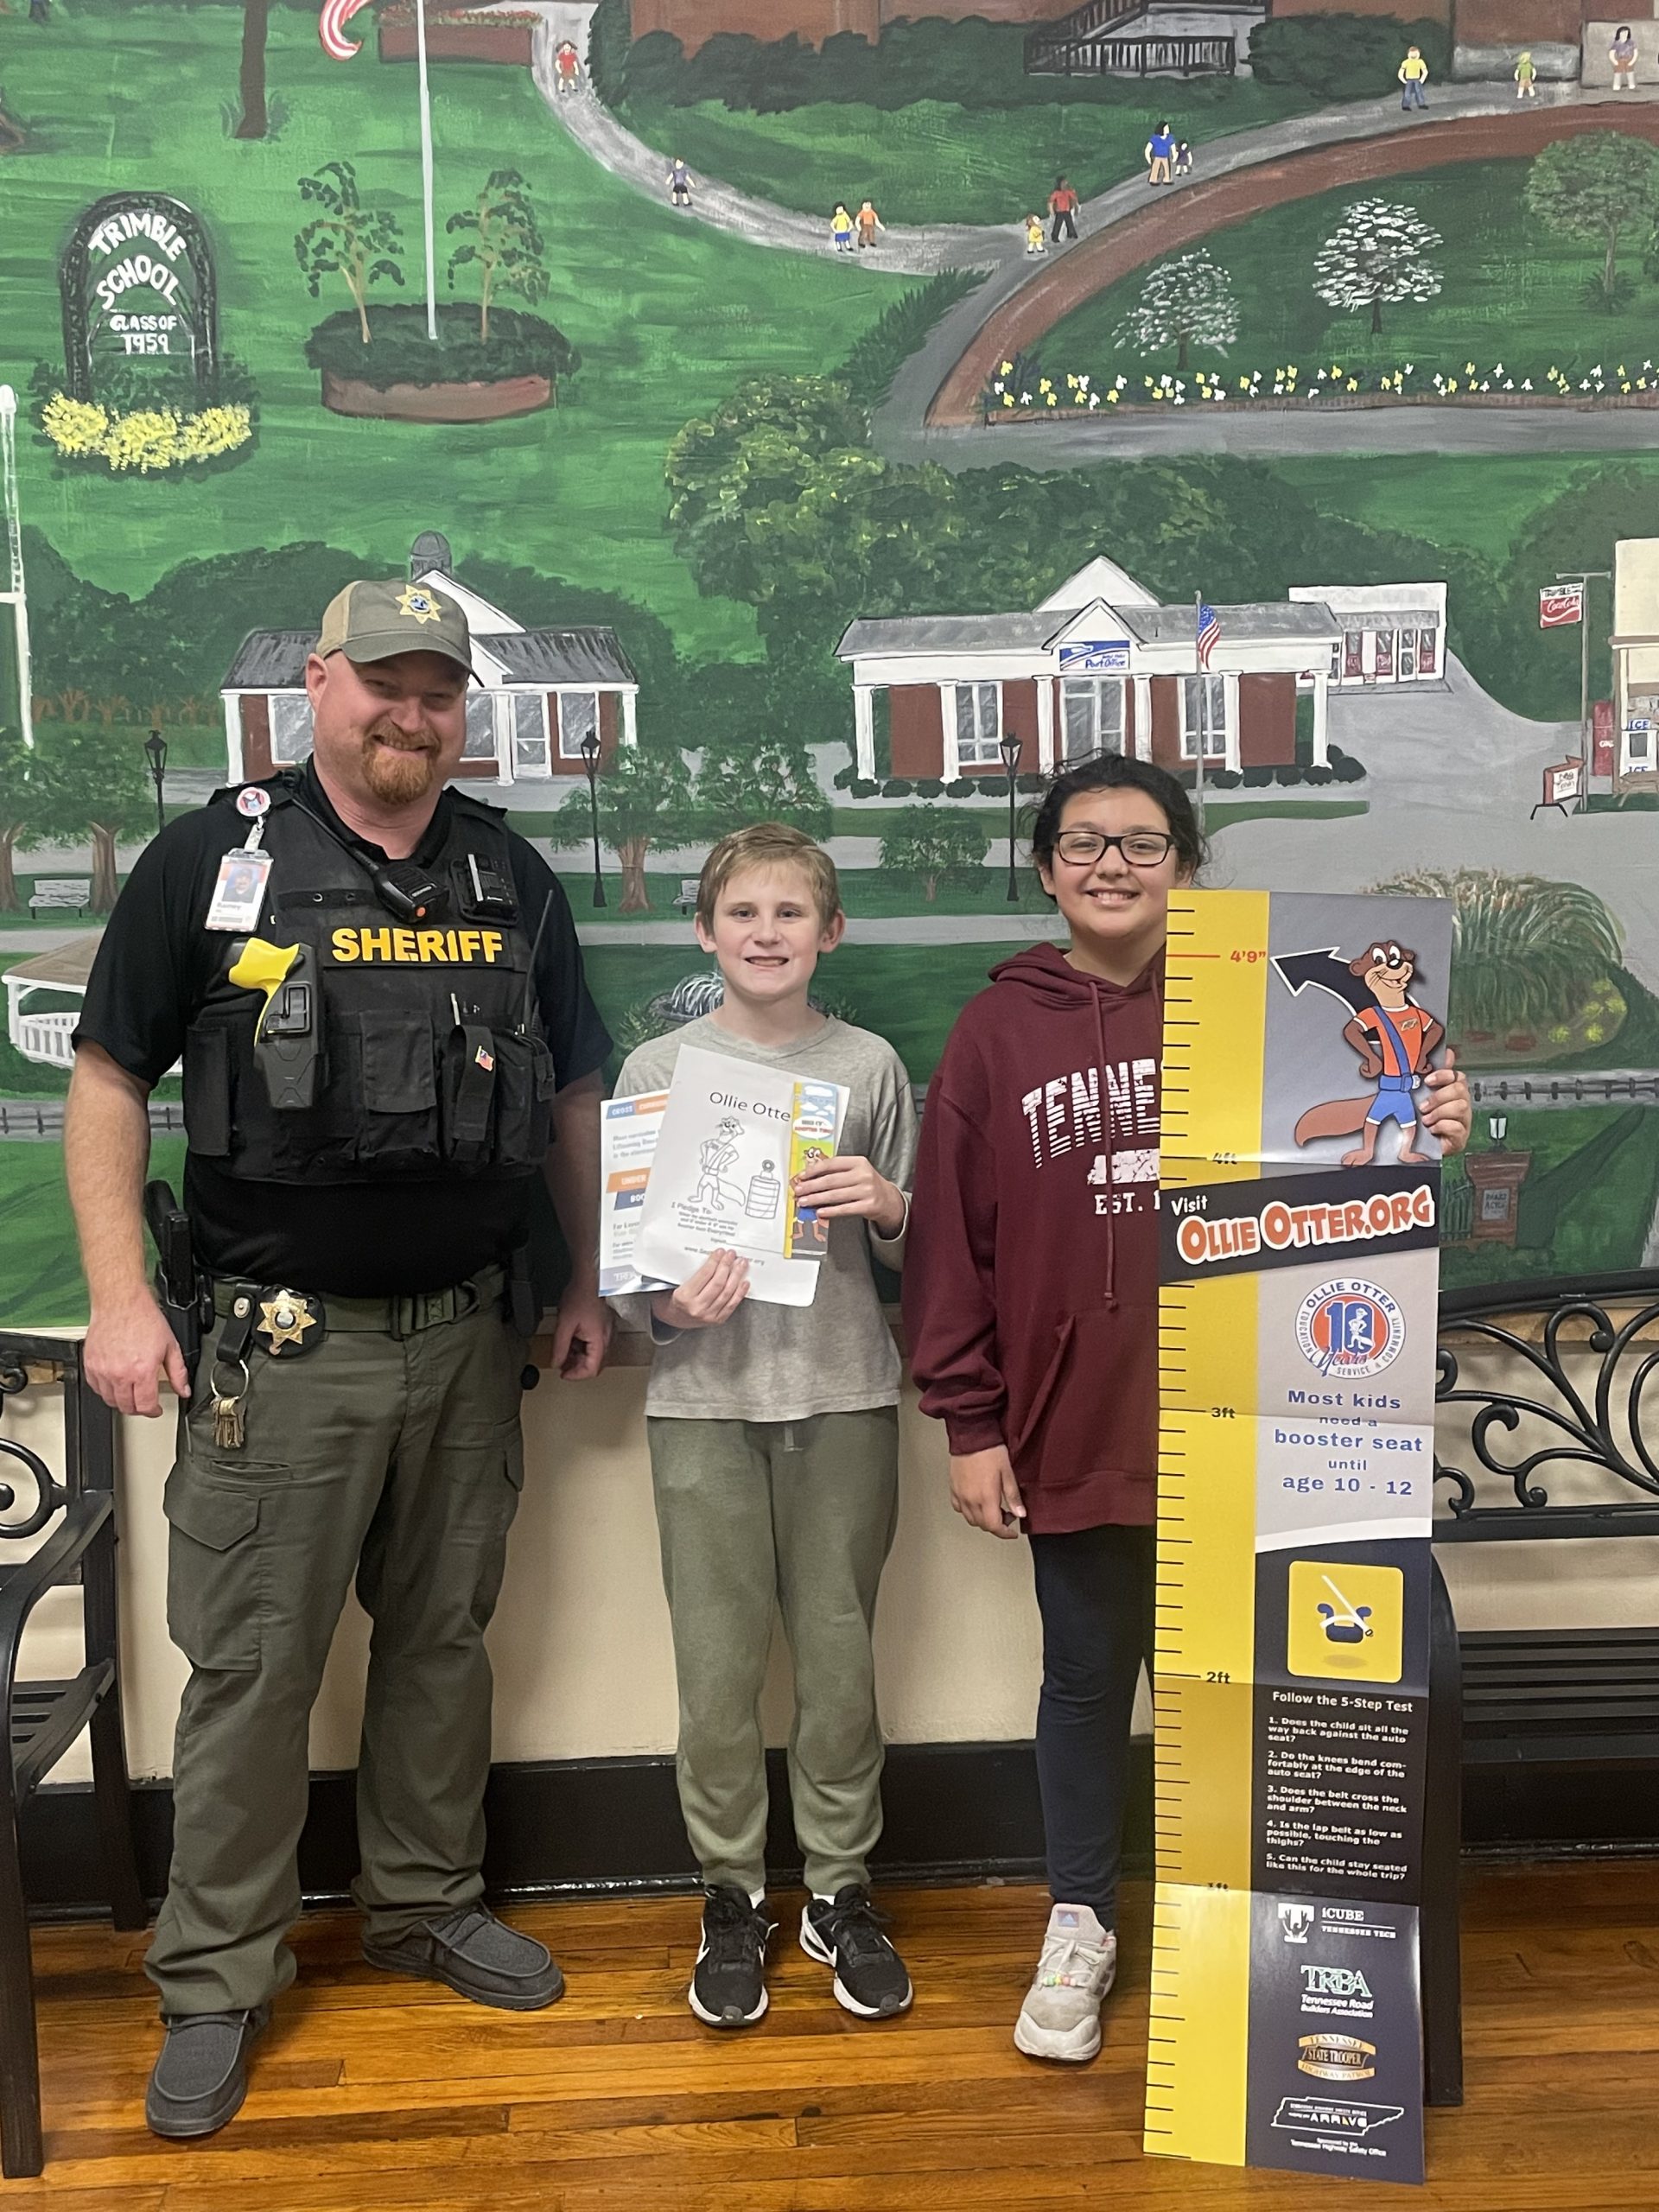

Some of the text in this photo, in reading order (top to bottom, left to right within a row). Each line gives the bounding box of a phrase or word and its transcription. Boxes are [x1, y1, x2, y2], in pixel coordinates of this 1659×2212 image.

[88, 213, 187, 262] TRIMBLE
[96, 254, 179, 310] SCHOOL
[158, 315, 177, 331] OF
[121, 333, 170, 355] 1959
[1085, 658, 1103, 670] Post
[1629, 720, 1650, 729] ICE
[331, 927, 503, 963] SHERIFF
[709, 1091, 791, 1122] Ollie Otte
[1094, 1192, 1144, 1215] EST.
[1171, 1194, 1208, 1216] Visit
[1179, 1188, 1432, 1262] OLLIE OTTER.ORG
[1306, 1281, 1396, 1313] OLLIE OTTER
[1325, 1302, 1373, 1354] 10
[1336, 1365, 1371, 1376] SERVICE
[1287, 1389, 1401, 1409] Most kids
[1211, 1407, 1235, 1419] 3ft
[1368, 1418, 1378, 1427] a
[1274, 1428, 1423, 1452] booster seat
[1328, 1459, 1367, 1471] until
[1282, 1476, 1325, 1493] age
[1334, 1478, 1360, 1492] 10
[1386, 1480, 1413, 1496] 12
[1206, 1671, 1230, 1685] 2ft
[1273, 1691, 1414, 1713] Follow the 5-Step Test
[1268, 1716, 1409, 1735] 1. Does the child sit all the
[1293, 1726, 1318, 1736] back
[1319, 1729, 1358, 1738] against
[1361, 1732, 1379, 1741] the
[1382, 1734, 1407, 1743] auto
[1268, 1759, 1308, 1770] fortably
[1325, 1764, 1343, 1772] the
[1344, 1766, 1371, 1776] edge
[1373, 1768, 1384, 1777] of
[1387, 1770, 1405, 1778] the
[1281, 1751, 1295, 1760] Do
[1298, 1753, 1315, 1762] the
[1318, 1754, 1348, 1764] knees
[1351, 1758, 1377, 1767] bend
[1380, 1760, 1407, 1769] com-
[1294, 1770, 1322, 1779] seat?
[1267, 1794, 1408, 1814] shoulder between the neck
[1280, 1786, 1306, 1796] Does
[1308, 1789, 1325, 1798] the
[1328, 1789, 1349, 1800] belt
[1351, 1793, 1379, 1802] cross
[1382, 1795, 1400, 1804] the
[1288, 1805, 1315, 1814] arm?
[1266, 1820, 1276, 1828] 4.
[1280, 1821, 1290, 1829] Is
[1293, 1821, 1310, 1831] the
[1313, 1823, 1329, 1833] lap
[1331, 1825, 1351, 1834] belt
[1369, 1828, 1388, 1837] low
[1266, 1829, 1381, 1846] possible, touching the
[1266, 1837, 1305, 1847] thighs?
[1266, 1853, 1408, 1872] 5. Can the child stay seated
[1266, 1860, 1406, 1880] like this for the whole trip?
[1322, 1906, 1364, 1922] iCUBE
[1300, 1964, 1373, 1998] TRBA
[1301, 1993, 1374, 2010] Tennessee Road
[1300, 2004, 1374, 2018] Builders Association
[1309, 2035, 1363, 2050] TENNESSEE
[1307, 2048, 1362, 2065] STATE TROOPER
